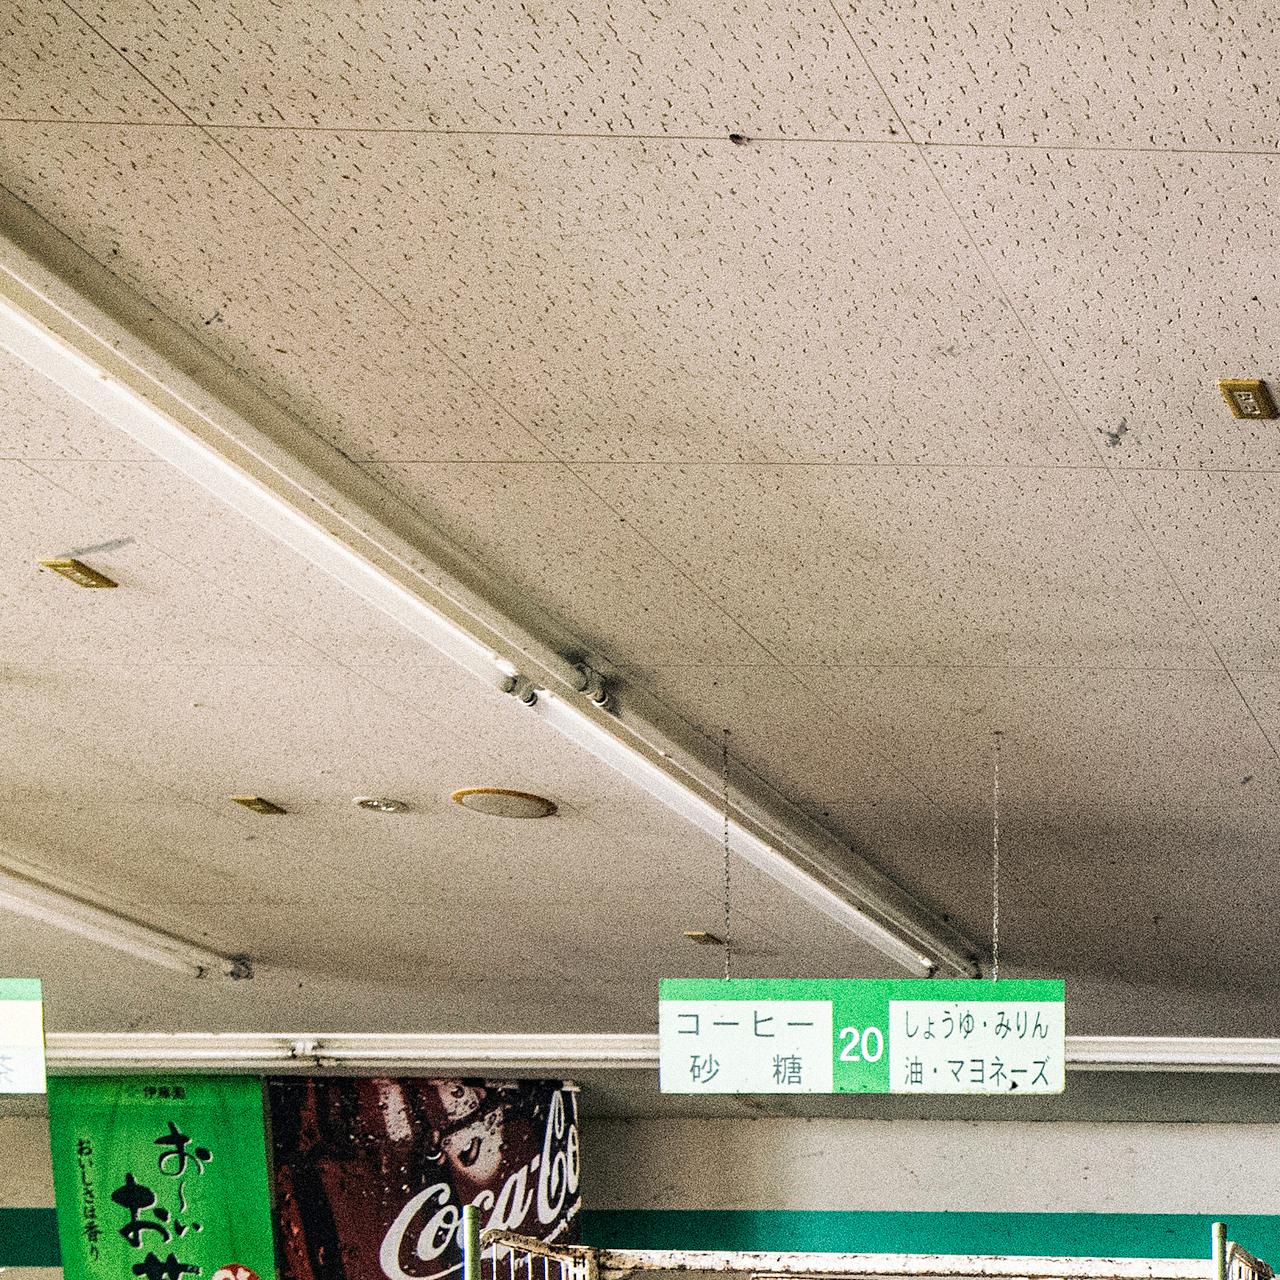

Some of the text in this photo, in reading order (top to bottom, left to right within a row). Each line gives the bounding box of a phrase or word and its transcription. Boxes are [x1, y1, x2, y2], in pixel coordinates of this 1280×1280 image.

[677, 1010, 814, 1037] コーヒー
[905, 1010, 1049, 1039] しょうゆ・みりん
[838, 1026, 884, 1062] 20
[690, 1053, 803, 1086] 砂糖
[904, 1056, 1050, 1086] 油・マヨネーズ
